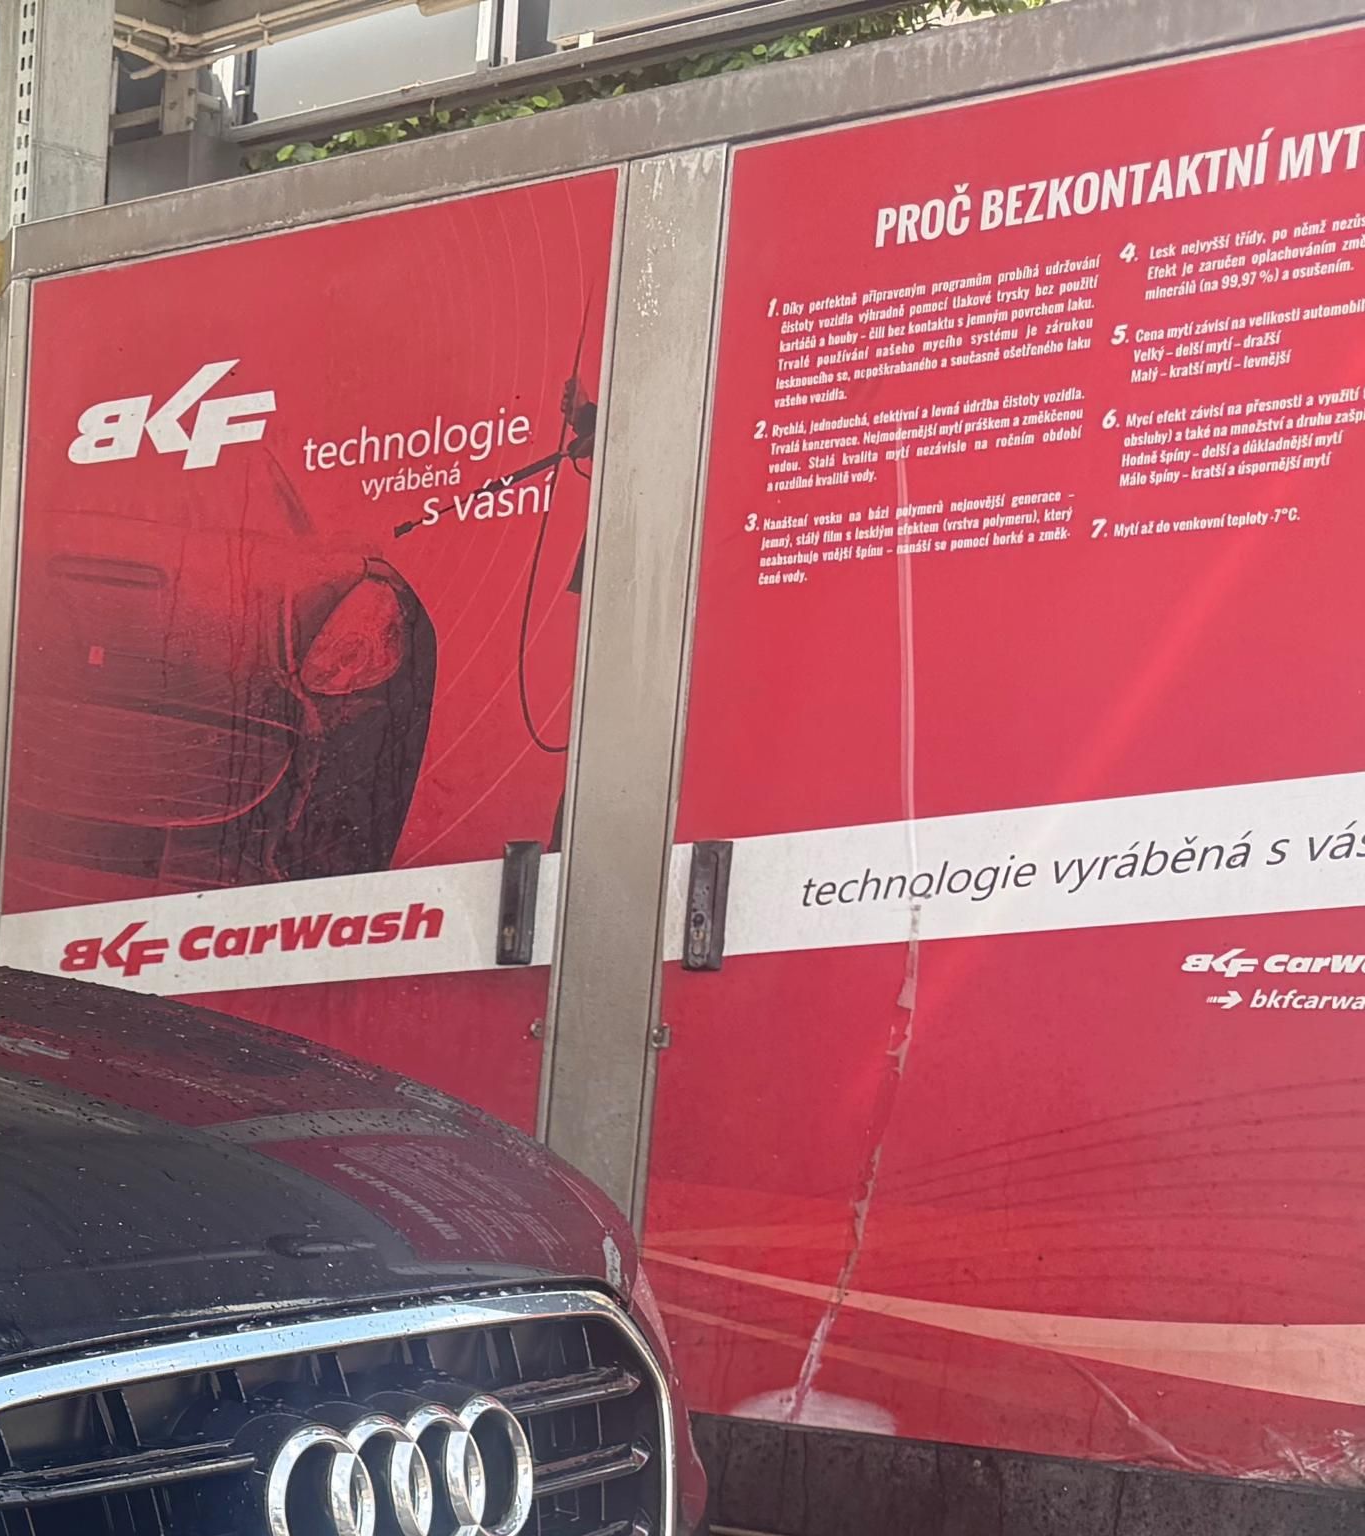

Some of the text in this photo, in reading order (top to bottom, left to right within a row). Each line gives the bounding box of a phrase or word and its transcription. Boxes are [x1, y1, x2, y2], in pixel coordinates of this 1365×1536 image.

[874, 124, 1365, 248] PROČ BEZKONTAKTNÍ MYT
[1119, 243, 1138, 262] 4.
[1149, 243, 1176, 259] Lesk
[1180, 233, 1230, 254] nejvyšší
[1234, 229, 1265, 246] třídy,
[1271, 228, 1287, 242] po
[1293, 219, 1326, 237] němž
[1147, 263, 1176, 280] Efekt
[1181, 262, 1193, 276] je
[1198, 254, 1245, 272] zaručen
[1251, 239, 1336, 266] oplachováním
[767, 255, 1100, 317] 1. Díky perfektně připraveným programům probíhá udržování
[1144, 258, 1353, 300] minerálů (na 99,97 %) a osušením.
[1110, 324, 1128, 344] 5.
[1135, 328, 1164, 342] Cena
[1166, 321, 1193, 338] mytí
[1194, 316, 1230, 334] závisí
[1230, 317, 1246, 329] na
[1248, 307, 1300, 327] velikosti
[1133, 329, 1281, 362] Velký delší mytí dražší
[1130, 349, 1291, 382] Malý kratší mytí levnější
[68, 358, 277, 470] BKF
[1101, 409, 1119, 429] 6.
[1125, 410, 1154, 427] Mycí
[1156, 407, 1186, 423] efekt
[1189, 402, 1224, 419] závisí
[1227, 403, 1242, 415] na
[1245, 394, 1302, 414] přesnosti
[1305, 395, 1313, 406] a
[1318, 386, 1360, 405] využití
[303, 407, 530, 471] technologie
[1121, 429, 1343, 467] Hodně špíny delší a důkladnější mytí
[1123, 428, 1172, 447] obsluhy)
[1174, 431, 1182, 441] a
[1184, 424, 1210, 440] také
[1212, 425, 1227, 437] na
[1230, 415, 1285, 435] množství
[1285, 418, 1293, 429] a
[1295, 412, 1332, 427] druhu
[361, 461, 461, 500] vyráběná
[1119, 451, 1331, 486] Málo špíny kratší a úspornější mytí
[422, 471, 555, 526] s vášní
[744, 491, 1061, 531] 3. Nanášení vosku na bázi polymerů nejnovější generace
[1091, 507, 1300, 538] 7. Mytí až do venkovní teploty -7°C.
[801, 854, 1036, 907] technologie
[1052, 830, 1253, 894] vyráběná
[1266, 837, 1289, 867] s
[60, 903, 445, 977] BKF CarWash
[1181, 947, 1260, 978] BKF
[1249, 987, 1365, 1011] bkfcarwa
